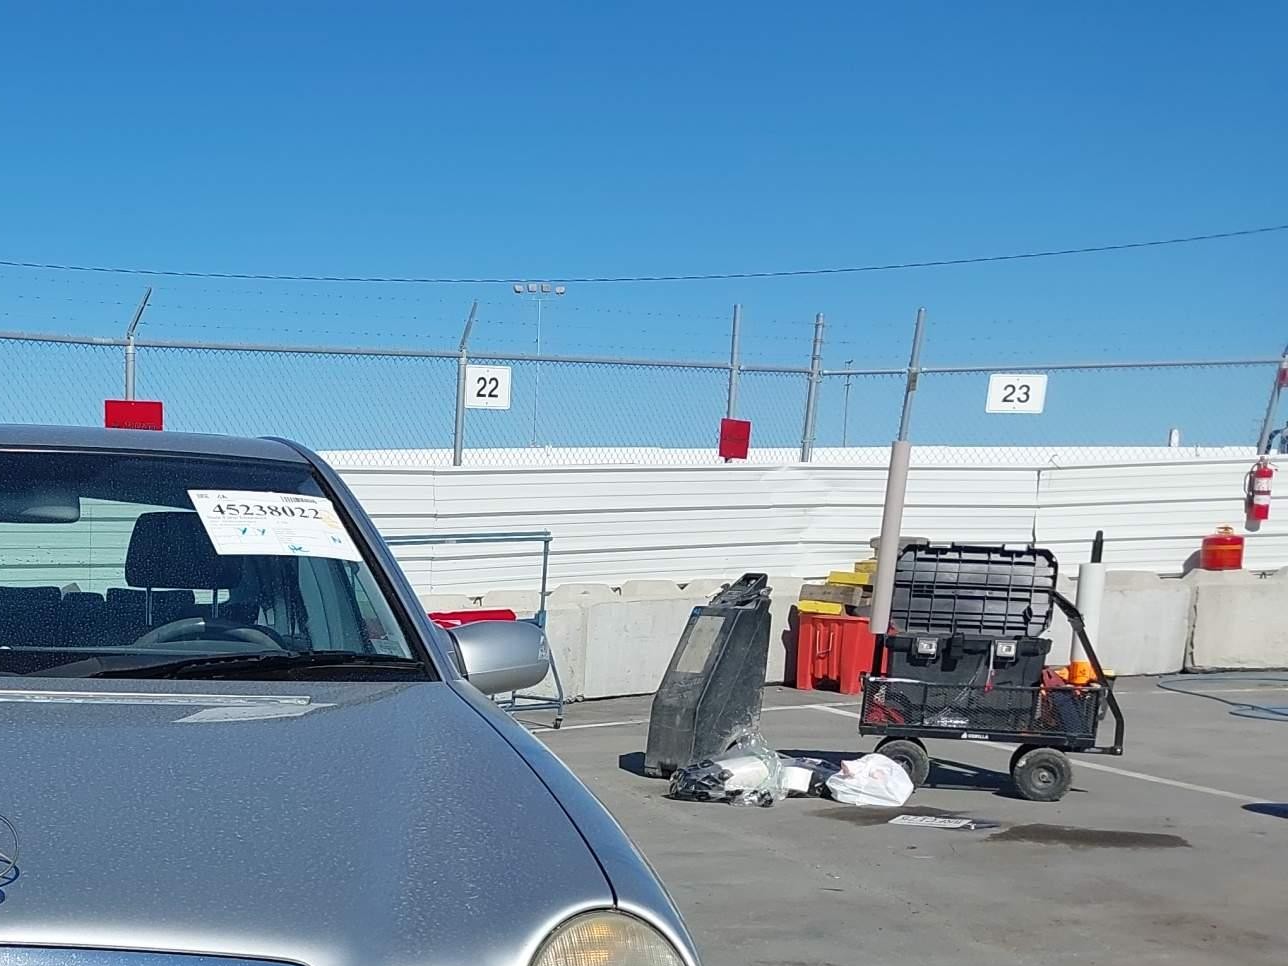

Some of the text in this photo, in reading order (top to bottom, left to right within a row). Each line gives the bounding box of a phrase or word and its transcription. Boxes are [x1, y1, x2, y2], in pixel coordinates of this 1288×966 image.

[476, 376, 499, 399] 22
[1002, 383, 1031, 404] 23
[212, 503, 323, 520] 45238022
